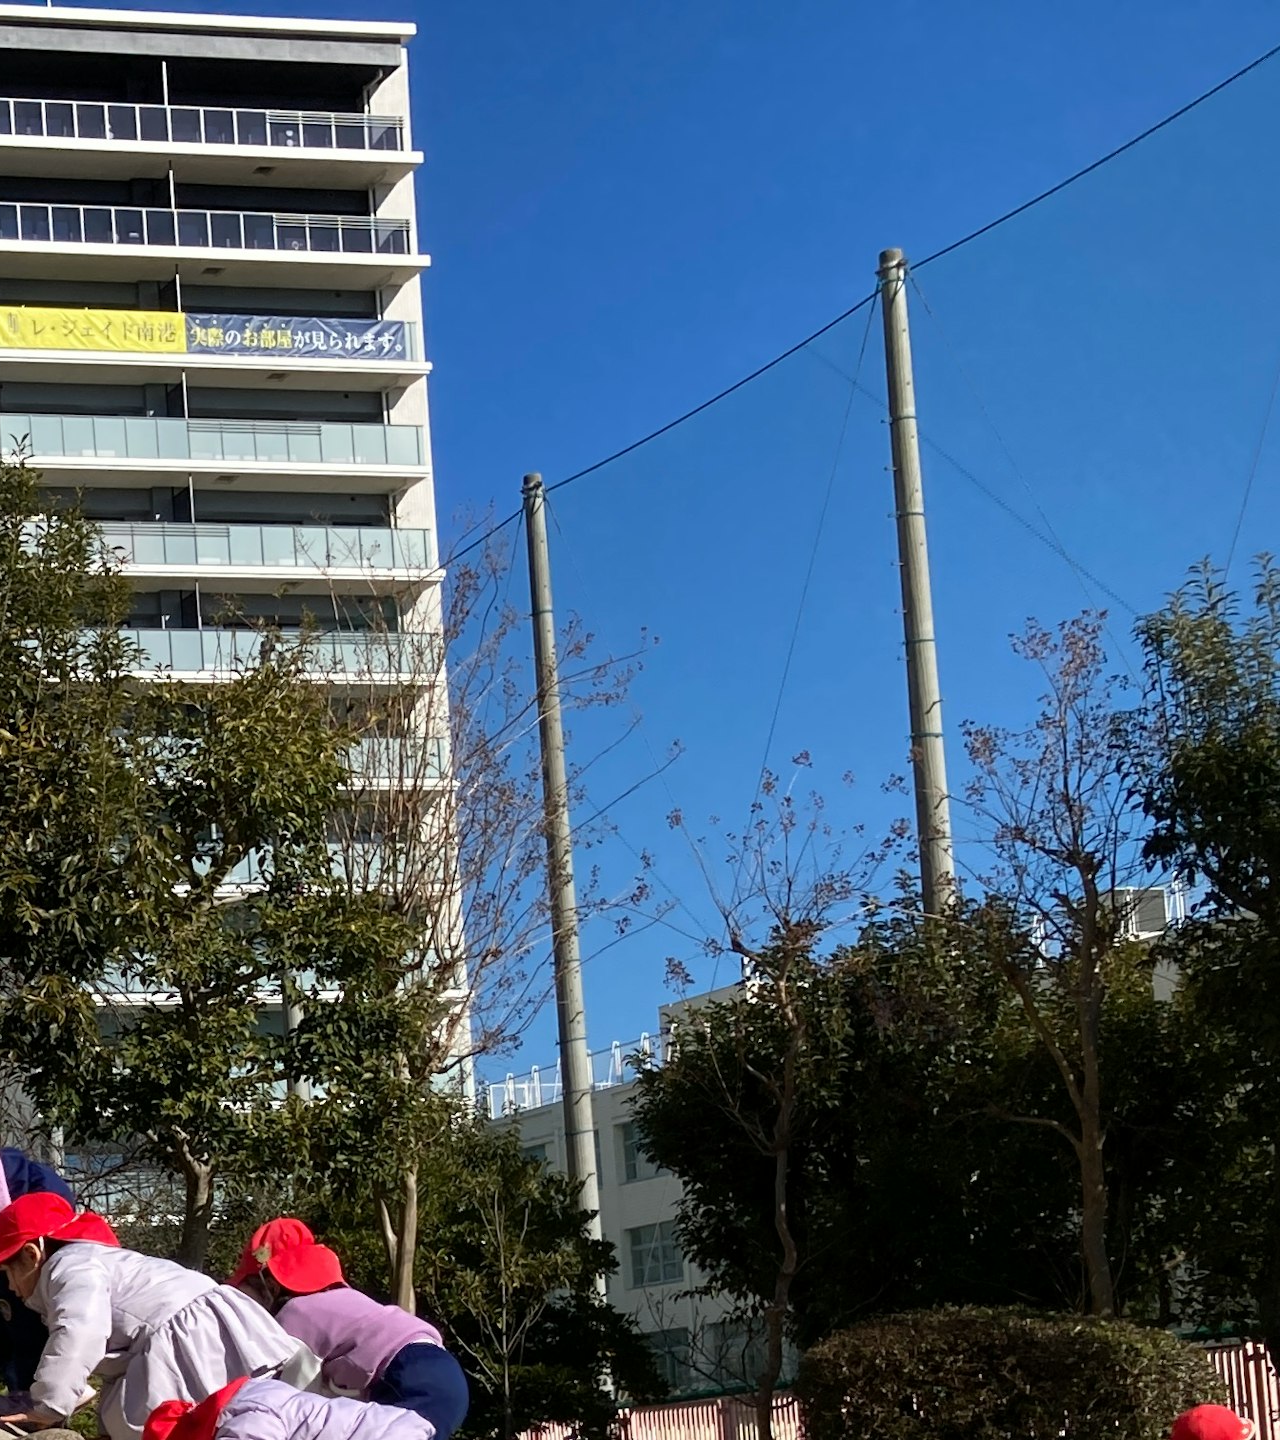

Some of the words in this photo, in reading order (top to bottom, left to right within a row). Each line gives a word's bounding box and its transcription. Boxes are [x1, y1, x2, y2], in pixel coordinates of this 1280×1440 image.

[190, 327, 404, 352] 実際のお部屋が見られます。
